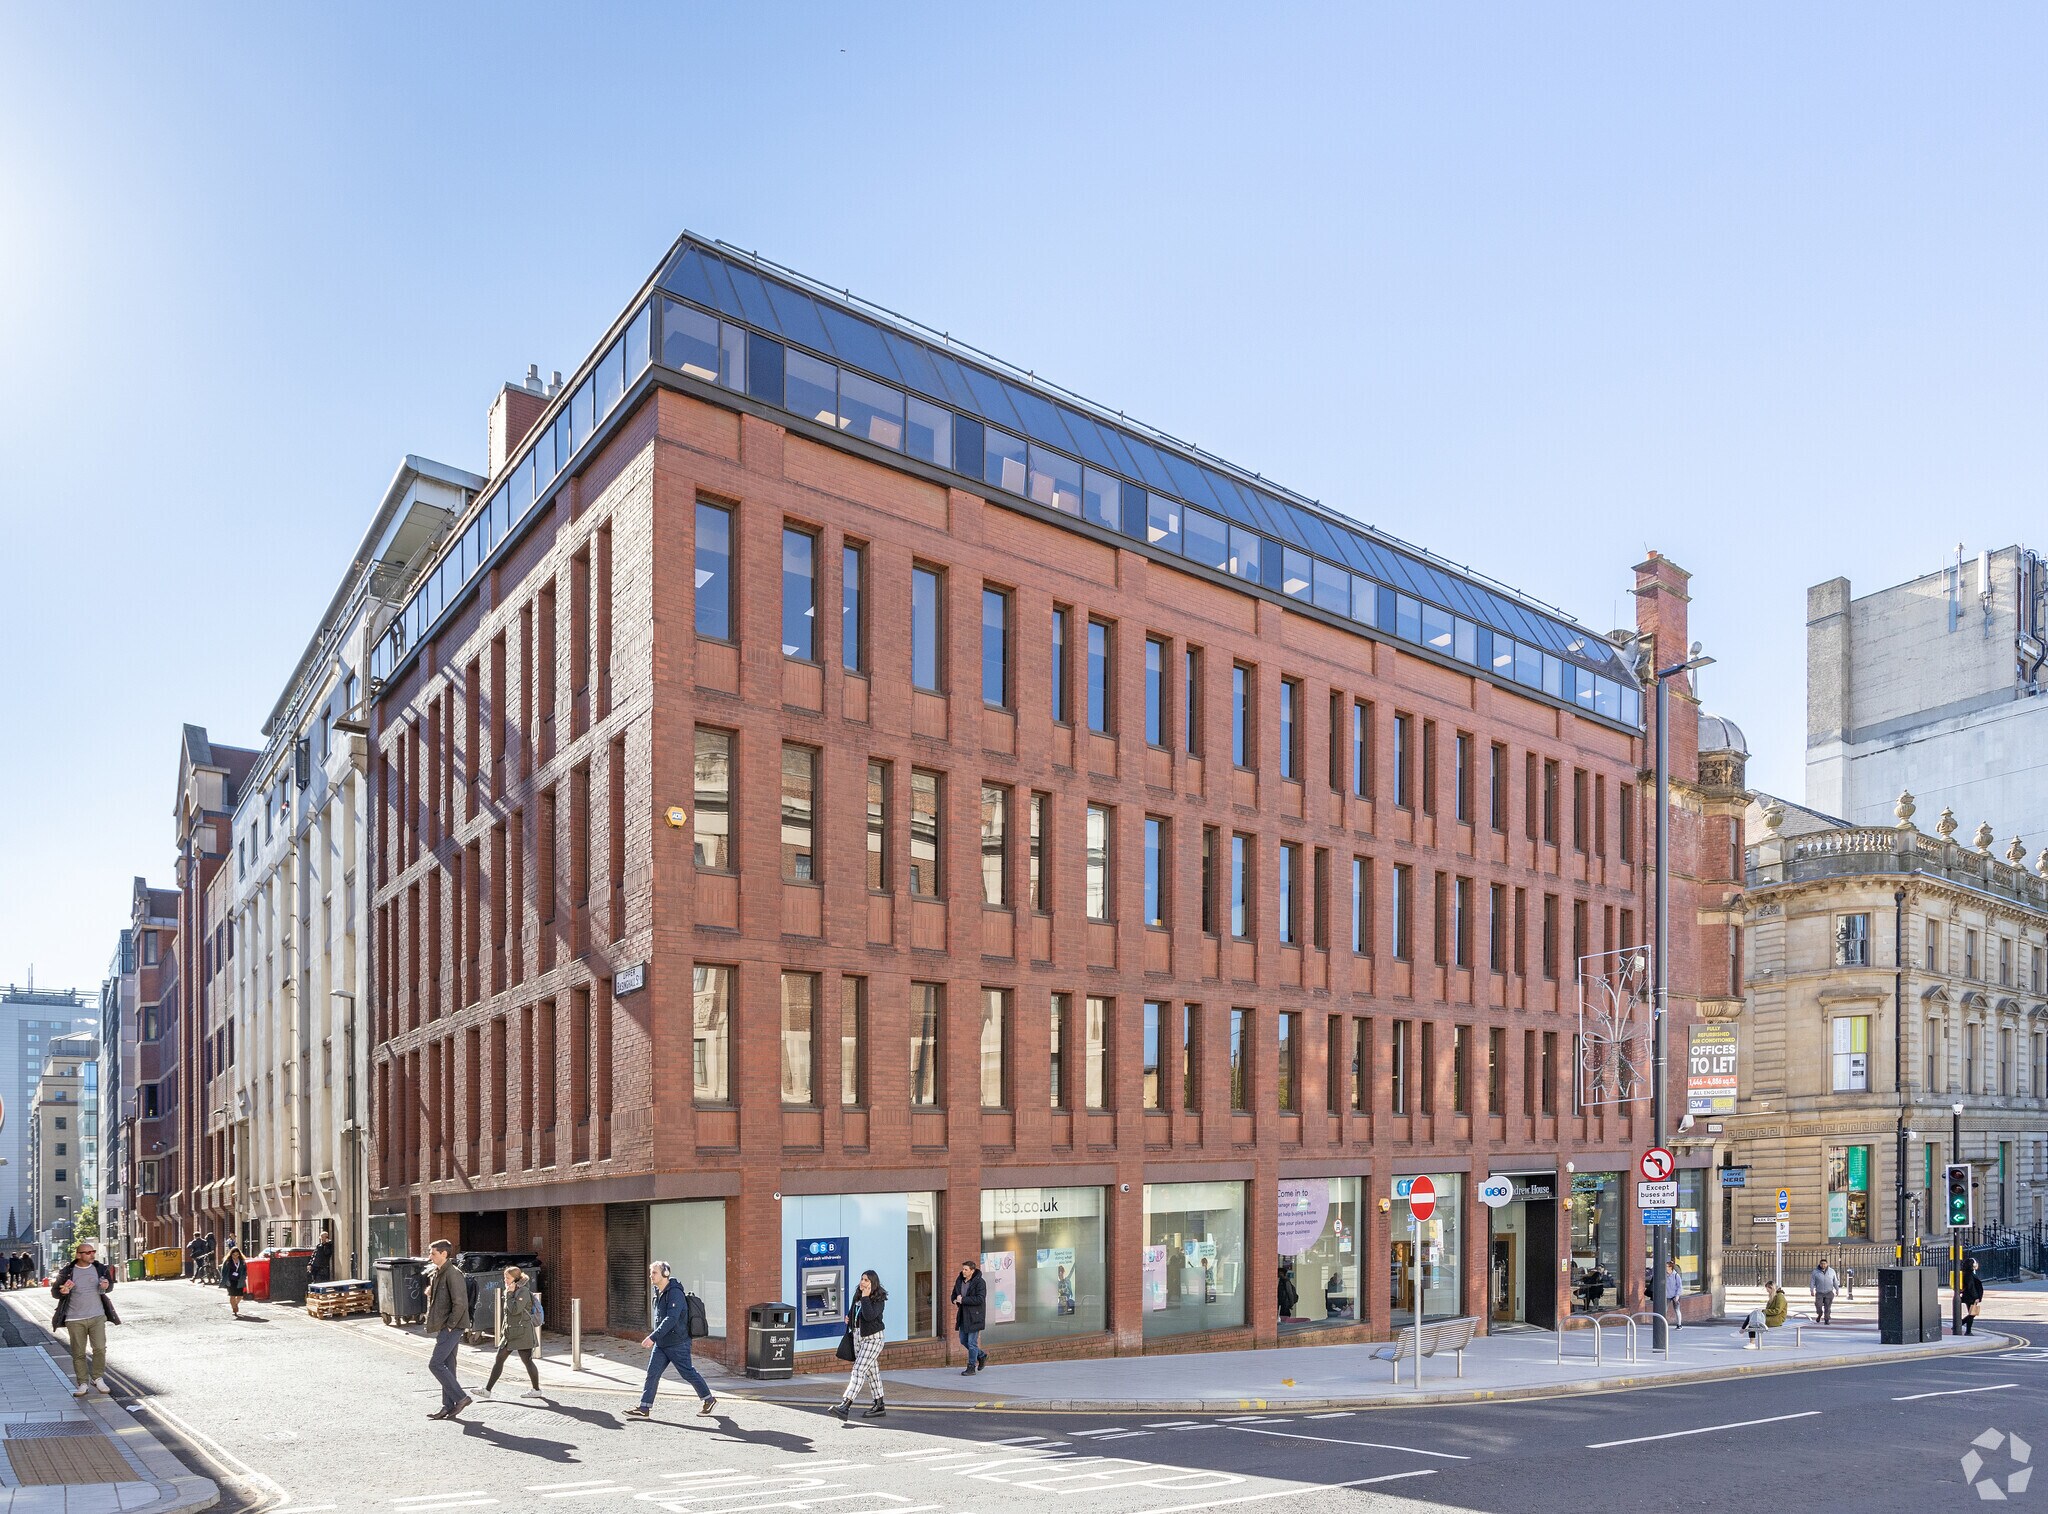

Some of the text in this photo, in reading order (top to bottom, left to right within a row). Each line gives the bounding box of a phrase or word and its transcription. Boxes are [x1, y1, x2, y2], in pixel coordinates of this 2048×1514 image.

[623, 968, 636, 980] UPPER
[1691, 1044, 1736, 1055] OFFICES
[1691, 1056, 1735, 1074] TO LET
[1512, 1184, 1549, 1195] ndrew House
[998, 1197, 1058, 1214] tsb.co.uk
[812, 1243, 835, 1252] TSB
[928, 1456, 1247, 1494] KEEP
